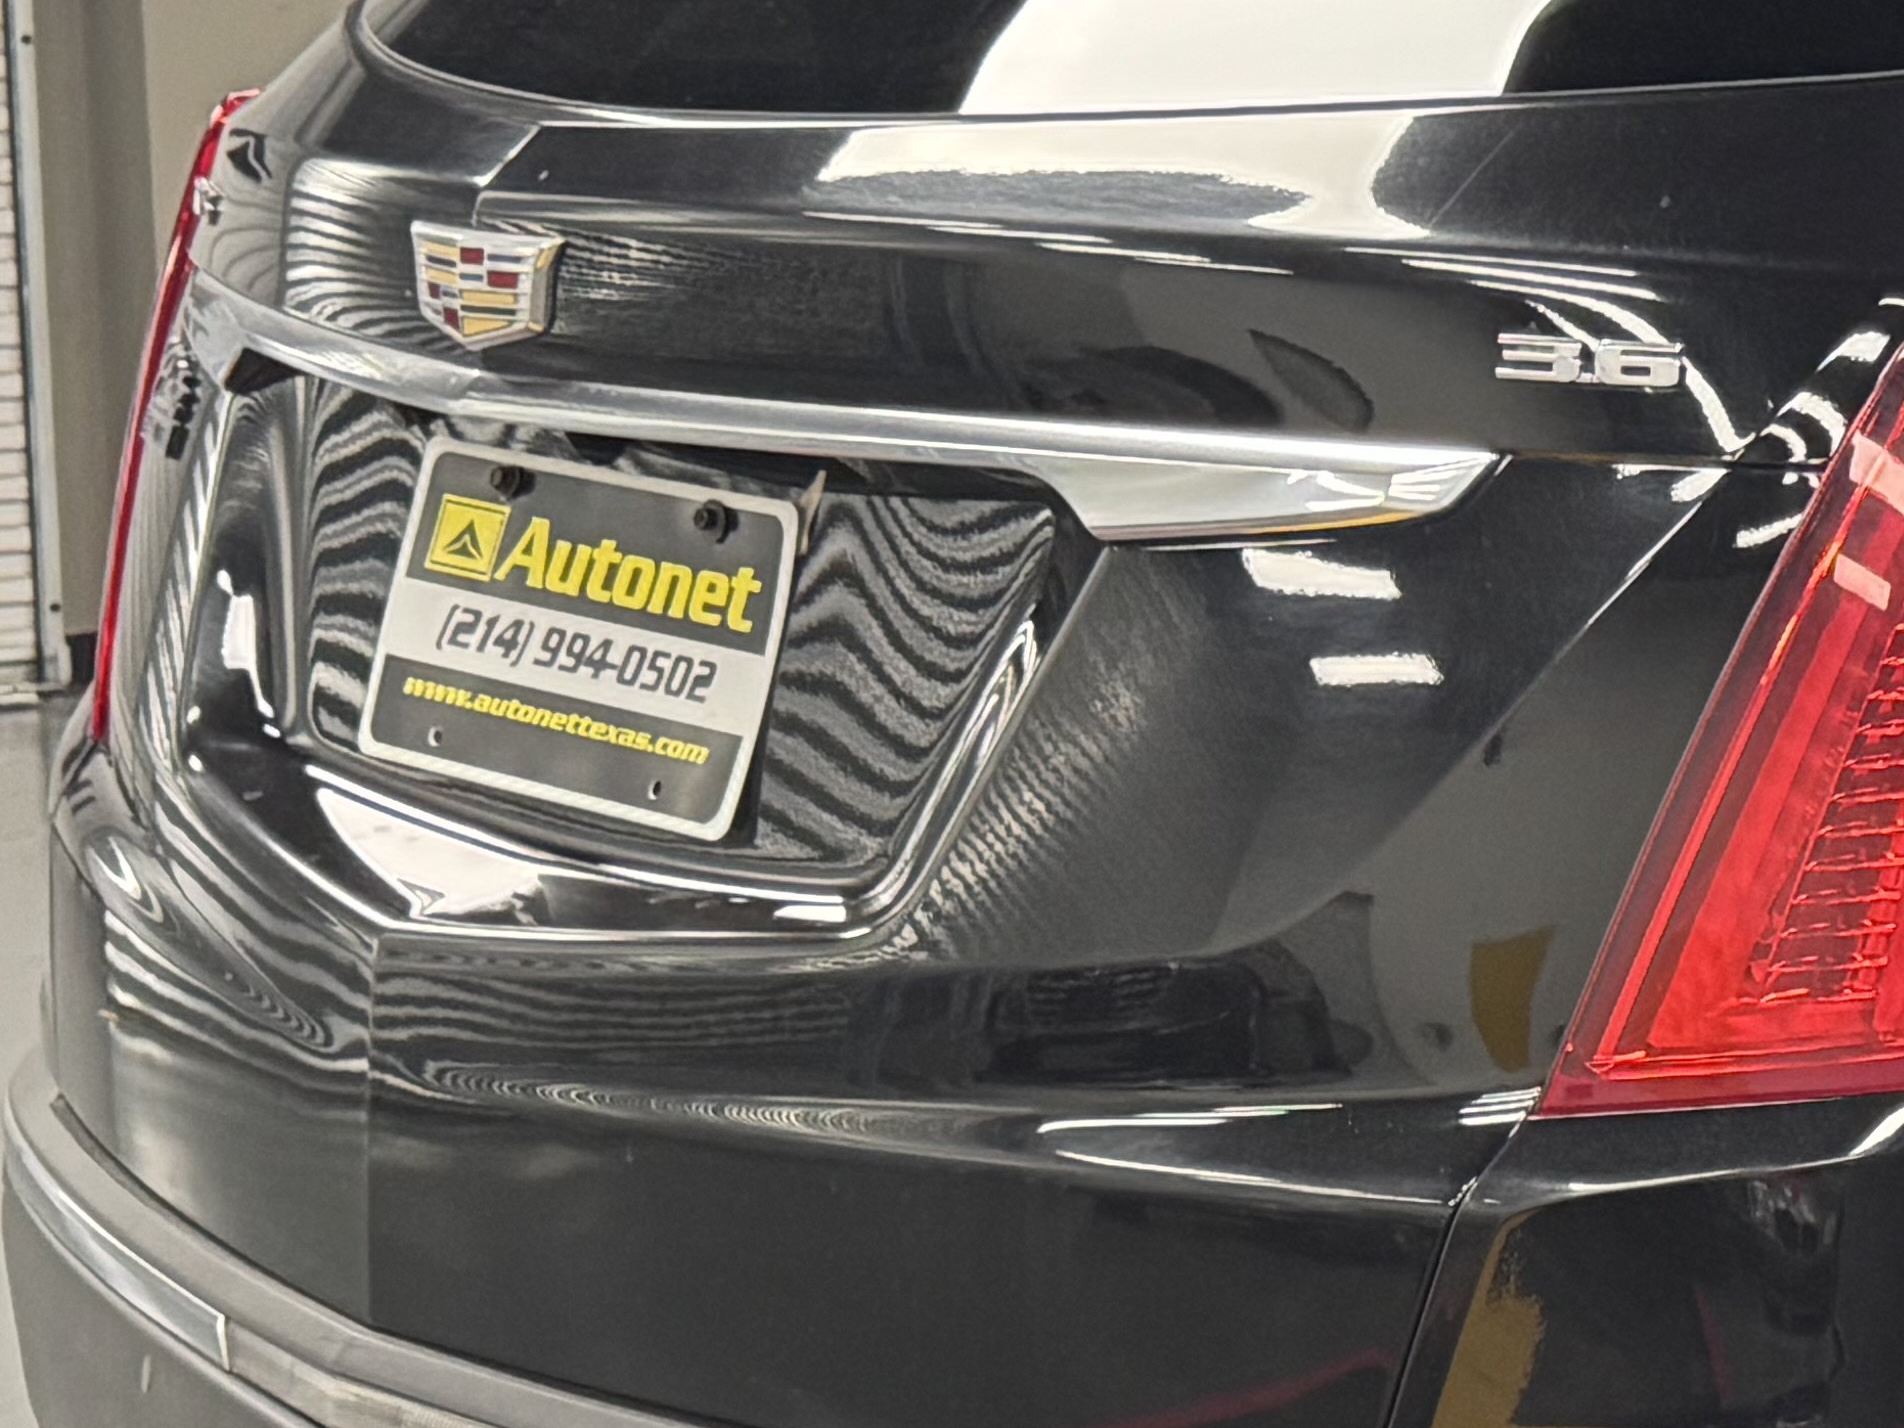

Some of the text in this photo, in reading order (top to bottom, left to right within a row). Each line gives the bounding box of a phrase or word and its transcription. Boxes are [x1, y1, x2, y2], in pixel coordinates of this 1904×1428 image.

[1495, 332, 1682, 388] 3.6
[494, 516, 762, 633] Autonet
[436, 603, 718, 704] (214) 994-0502
[403, 676, 710, 765] www.autonettexas.com
